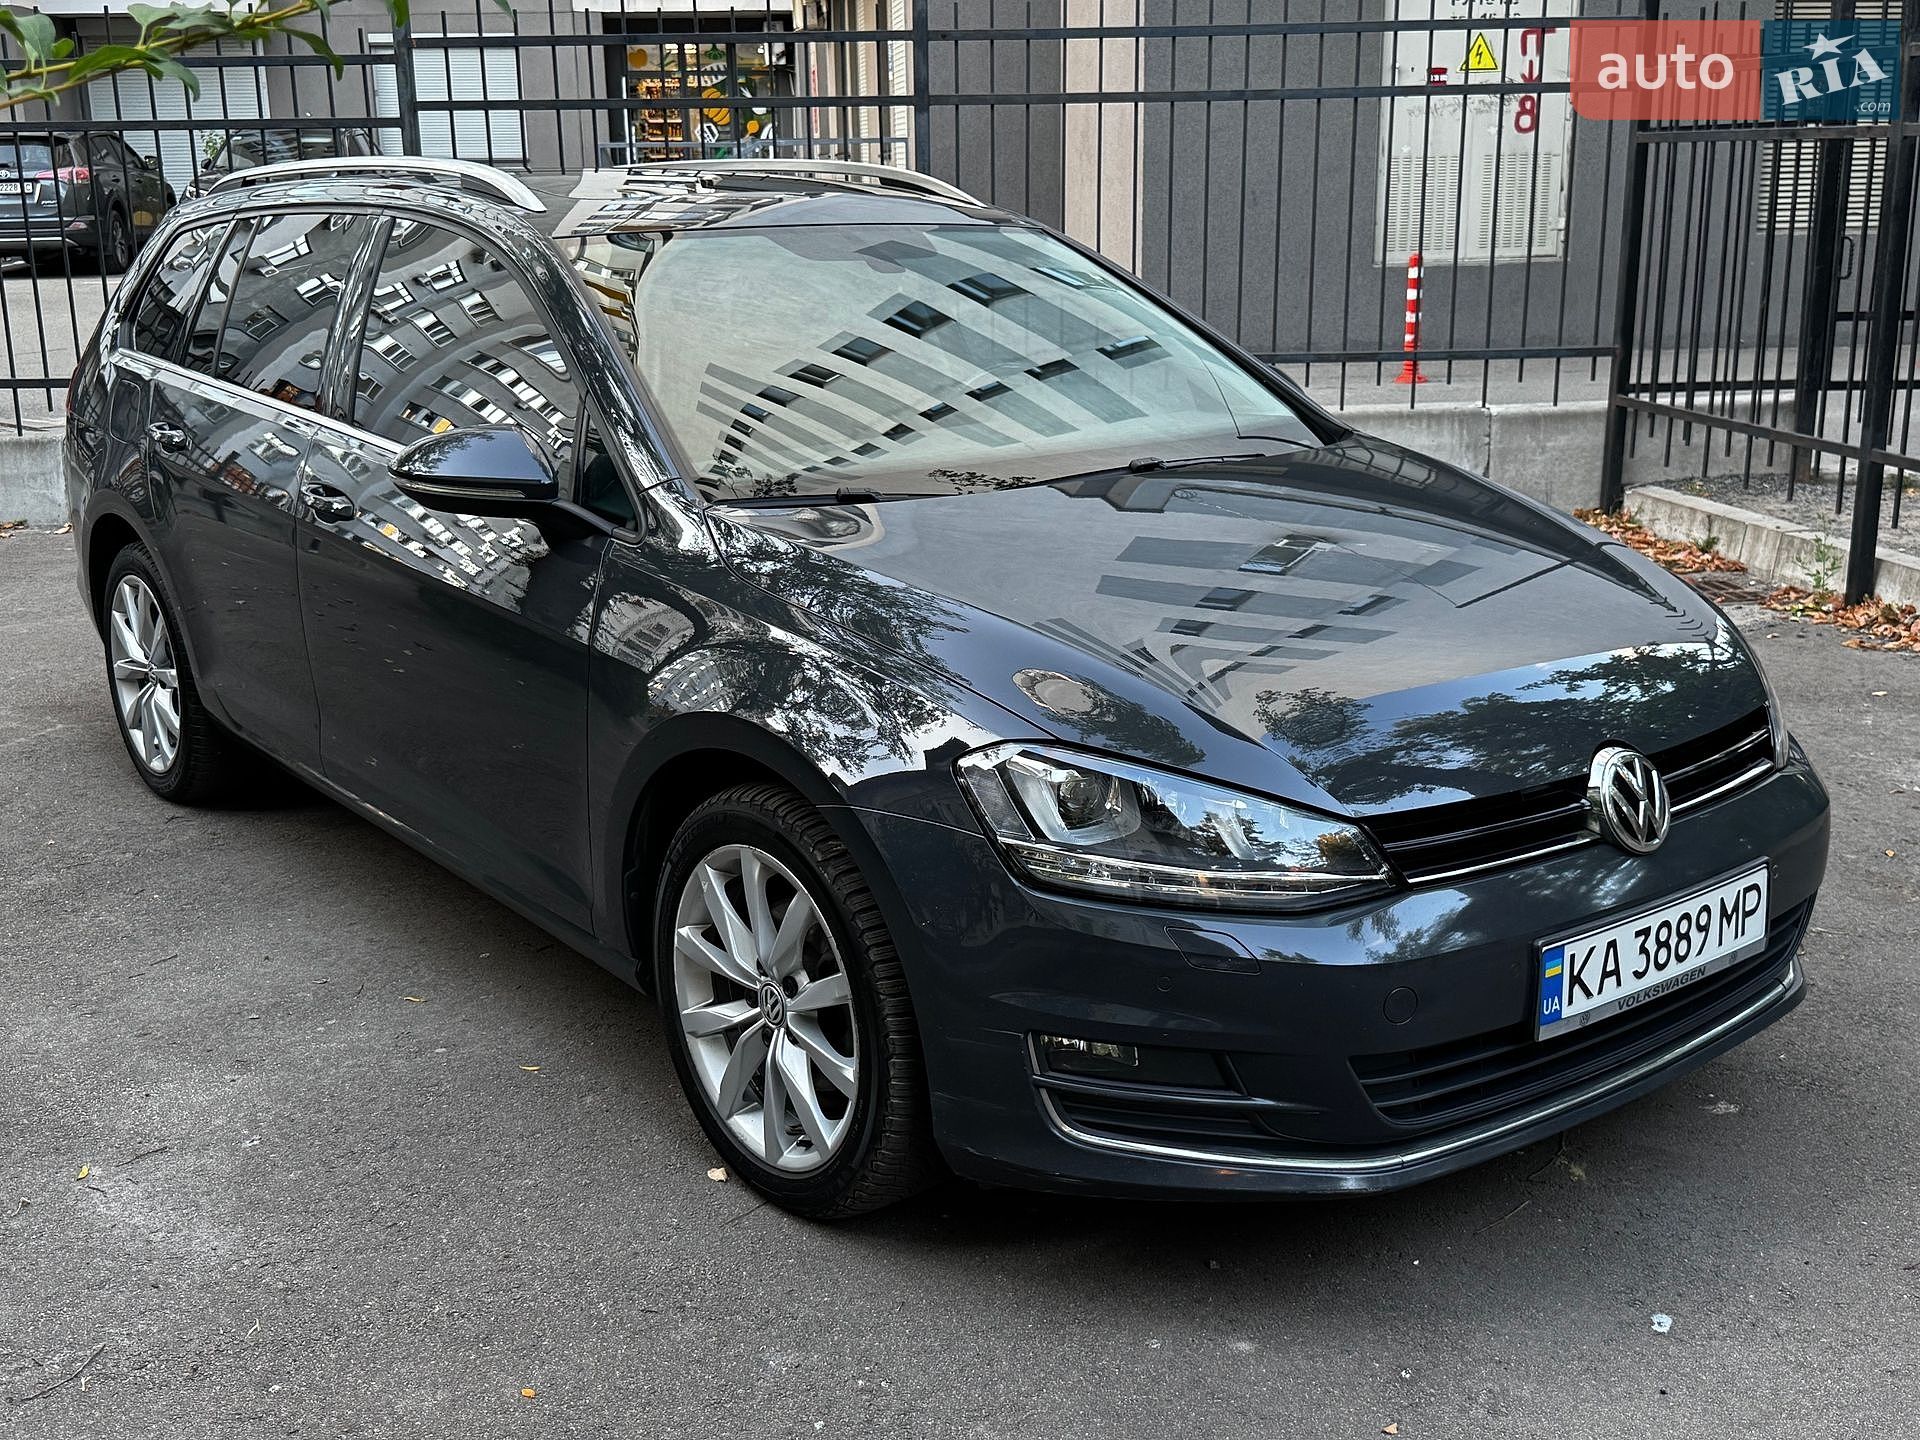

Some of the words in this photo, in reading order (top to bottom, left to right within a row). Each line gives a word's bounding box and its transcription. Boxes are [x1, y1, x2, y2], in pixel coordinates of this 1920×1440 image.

[1567, 938, 1622, 1007] KA
[1632, 903, 1712, 980] 3889
[1718, 883, 1762, 947] MP
[1543, 995, 1560, 1015] UA
[1617, 965, 1706, 1011] VOLKSWAGEN
